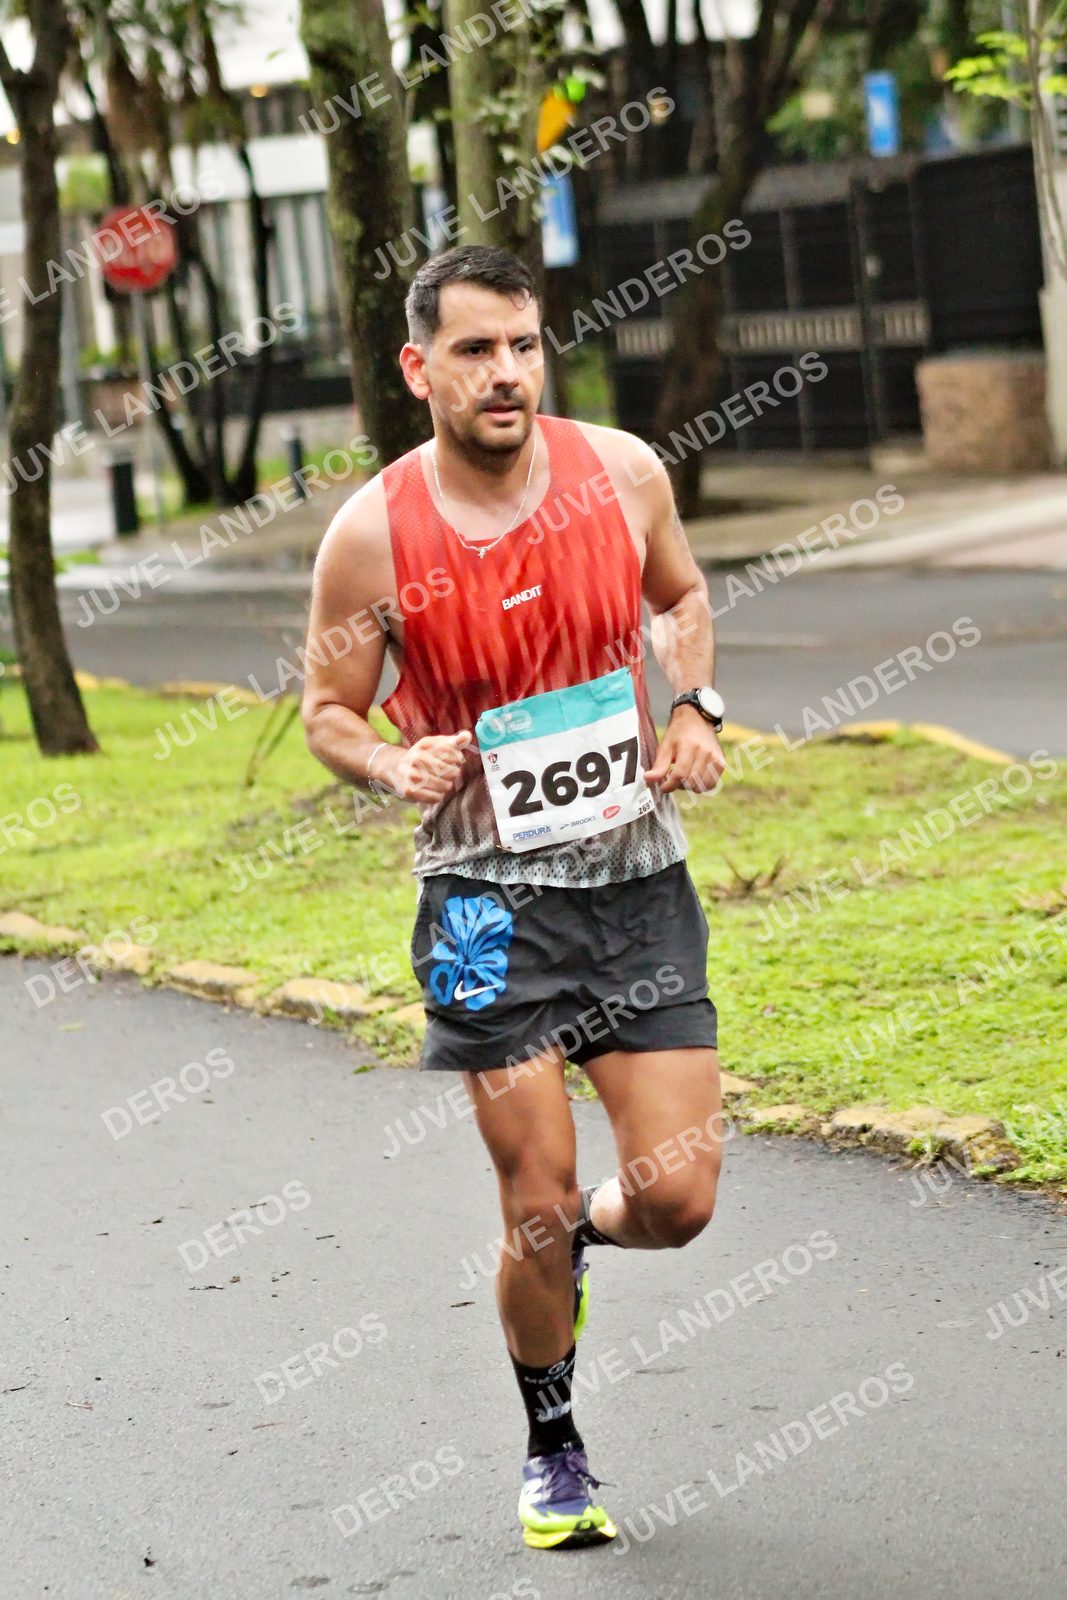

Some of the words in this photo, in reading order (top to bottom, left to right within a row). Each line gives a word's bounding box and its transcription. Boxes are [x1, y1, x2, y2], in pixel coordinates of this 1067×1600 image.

[501, 585, 542, 610] BANDIT
[501, 736, 639, 817] 2697
[512, 826, 551, 841] PERDURA
